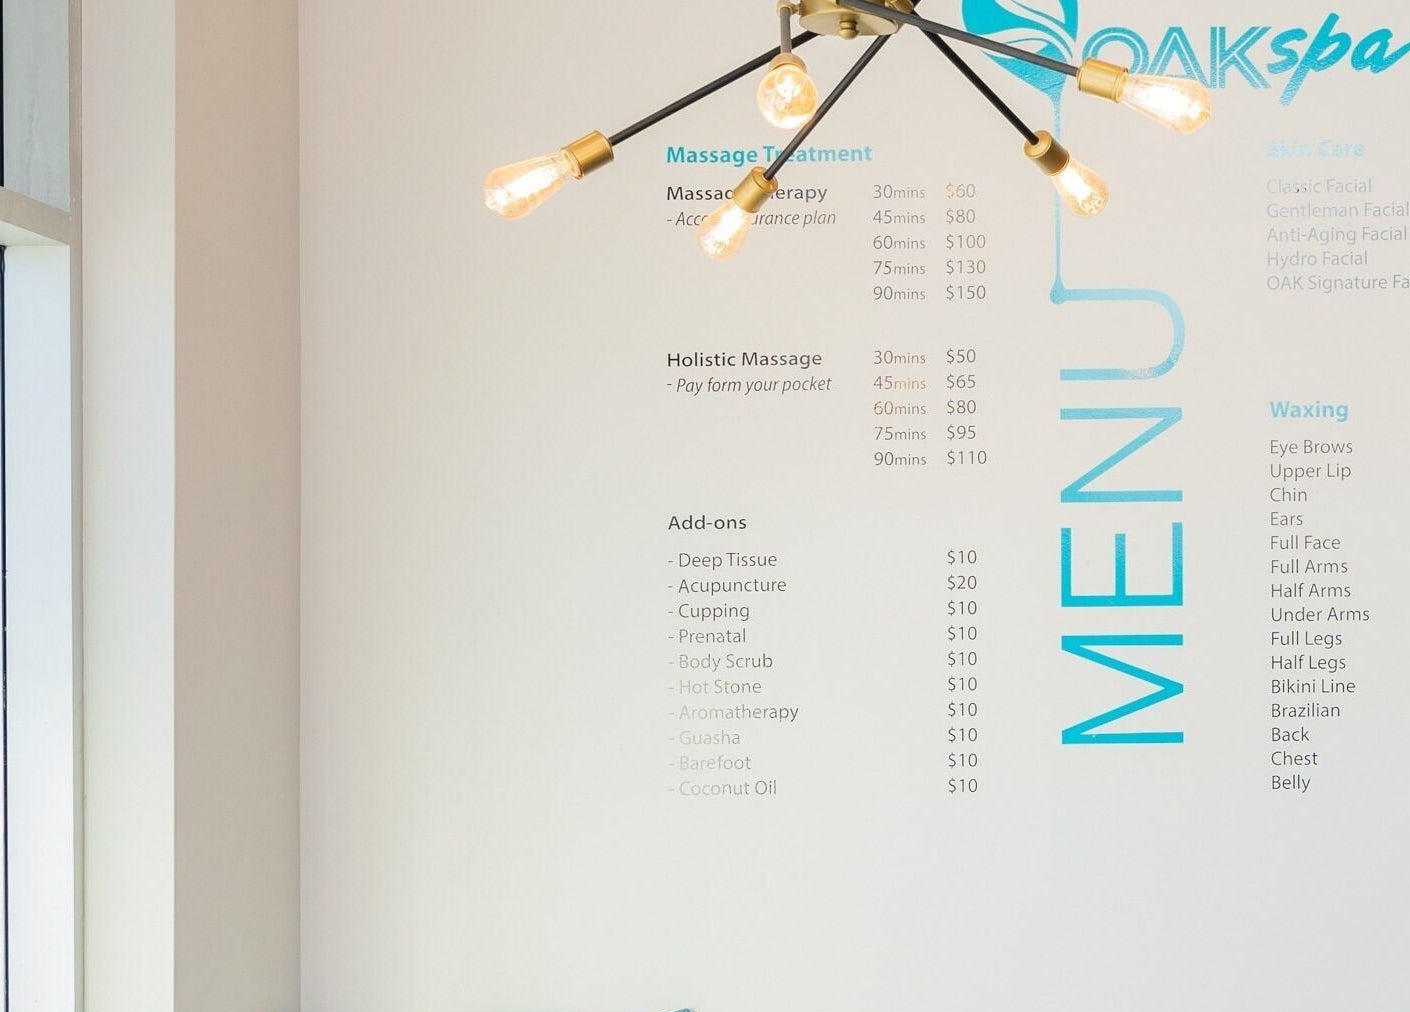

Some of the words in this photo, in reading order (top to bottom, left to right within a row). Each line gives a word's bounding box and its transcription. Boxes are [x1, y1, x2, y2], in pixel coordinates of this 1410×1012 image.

[667, 147, 757, 167] Massage
[762, 145, 872, 162] Tratment
[769, 185, 828, 202] erapy
[1267, 179, 1321, 194] Classic
[1327, 176, 1371, 193] Facial
[946, 208, 975, 224] $80
[1267, 200, 1359, 218] Gentleman
[752, 212, 800, 226] urance
[803, 210, 835, 228] plan
[947, 234, 985, 250] $100
[1267, 227, 1356, 245] Anti-Aging
[947, 258, 985, 275] $130
[1268, 250, 1317, 270] Hydro
[1323, 250, 1367, 265] Facial
[874, 286, 925, 300] 90mins
[947, 285, 985, 300] $150
[1267, 276, 1303, 290] OAK
[1308, 275, 1387, 293] Signature
[668, 352, 735, 367] Holistic
[742, 352, 821, 369] Massage
[874, 351, 925, 364] 30mins
[947, 349, 975, 364] $50
[677, 379, 703, 396] Pay
[708, 377, 741, 392] form
[745, 381, 779, 395] your
[782, 376, 832, 395] pocket
[874, 401, 926, 415] 60mins
[1270, 401, 1348, 422] Waxing
[947, 425, 975, 440] $95
[874, 452, 926, 465] 90mins
[948, 450, 986, 465] $110
[1271, 440, 1298, 458] Eye
[1304, 440, 1352, 454] Brows
[1271, 464, 1321, 481] Upper
[1328, 464, 1351, 480] Lip
[1270, 487, 1307, 502] Chin
[668, 515, 746, 530] Add-ons
[1050, 288, 1185, 744] MENU
[1271, 512, 1303, 526] Ears
[1271, 535, 1298, 549] Full
[1305, 536, 1340, 549] Face
[679, 553, 722, 570] Deep
[726, 553, 777, 566] Tissue
[948, 550, 976, 565] $10
[1272, 559, 1298, 574] Full
[1305, 560, 1347, 573] Arms
[679, 579, 786, 596] Acupuncture
[948, 575, 976, 591] $20
[1272, 583, 1304, 597] Half
[1309, 584, 1350, 597] Arms
[679, 604, 749, 621] Cupping
[1272, 607, 1322, 622] Under
[1328, 607, 1369, 621] Arms
[679, 628, 745, 643] Prenatal
[1272, 631, 1298, 645] Full
[1306, 632, 1342, 649] Legs
[680, 653, 720, 672] Body
[727, 653, 772, 668] Scrub
[948, 651, 977, 667] $10
[1272, 655, 1304, 669] Half
[1310, 656, 1345, 673] Legs
[680, 680, 709, 694] Hot
[715, 680, 761, 694] Stone
[1272, 679, 1315, 693] Bikini
[1322, 679, 1355, 693] Line
[681, 704, 798, 722] Aromatherapy
[1272, 703, 1340, 717] Brazilian
[680, 730, 740, 744] Guasha
[1272, 727, 1309, 741] Back
[680, 755, 752, 770] Barefoot
[1272, 751, 1317, 765] Chest
[680, 781, 751, 796] Coconut
[755, 780, 776, 795] Oil
[949, 778, 977, 794] $10
[1272, 775, 1310, 793] Belly
